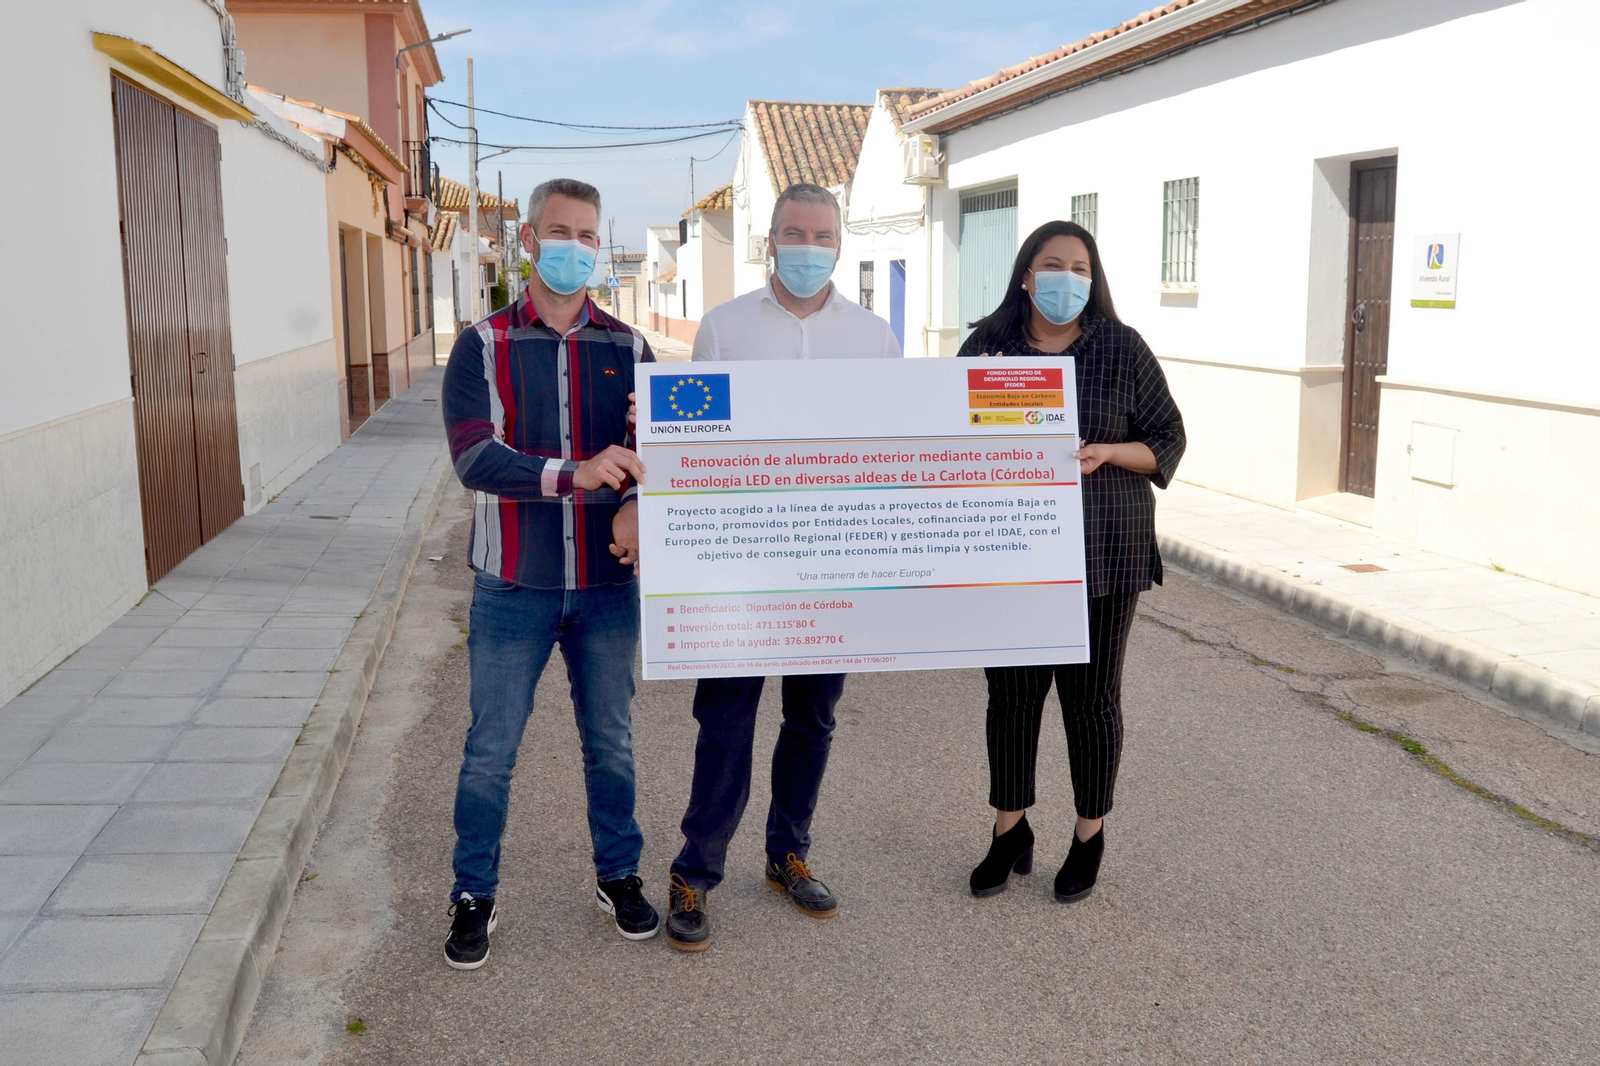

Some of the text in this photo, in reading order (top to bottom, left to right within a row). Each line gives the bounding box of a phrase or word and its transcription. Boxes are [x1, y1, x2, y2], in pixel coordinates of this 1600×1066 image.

[650, 424, 731, 434] UNIÓN EUROPEA
[681, 448, 1043, 468] Renovación de alumbrado exterior mediante cambio a
[670, 467, 1054, 488] tecnología LED en diversas aldeas de La Carlota (Córdoba)
[667, 507, 716, 517] Proyecto
[720, 505, 763, 516] acogido
[776, 504, 786, 513] la
[790, 504, 816, 512] línea
[820, 503, 834, 511] de
[837, 502, 876, 513] ayudas
[889, 502, 942, 511] proyectos
[945, 500, 958, 508] de
[962, 498, 1013, 508] Economía
[1017, 498, 1039, 508] Baja
[668, 512, 1056, 531] Carbono, promovidos por Entidades Locales, cofinanciada por el Fondo
[665, 538, 711, 547] Europeo
[715, 536, 728, 544] de
[732, 534, 790, 544] Desarrollo
[794, 532, 841, 543] Regional
[845, 531, 887, 542] (FEDER)
[900, 529, 959, 541] gestionada
[963, 530, 981, 539] por
[984, 528, 994, 537] el
[998, 528, 1025, 537] IDAE,
[1051, 526, 1060, 535] el
[697, 550, 742, 561] objetivo
[746, 550, 759, 558] de
[763, 548, 817, 559] conseguir
[844, 546, 898, 555] economía
[902, 544, 923, 553] más
[927, 544, 960, 554] limpia
[973, 542, 1031, 552] sostenible.
[796, 572, 818, 580] “Una
[857, 570, 869, 578] de
[871, 570, 897, 578] hacer
[899, 568, 935, 578] Europa”
[680, 600, 853, 614] Beneficiario: Diputación de Córdoba
[679, 619, 815, 632] Inversión total: 471.115’80 €
[680, 635, 844, 651] Importe de la ayuda: 376.892’70 €
